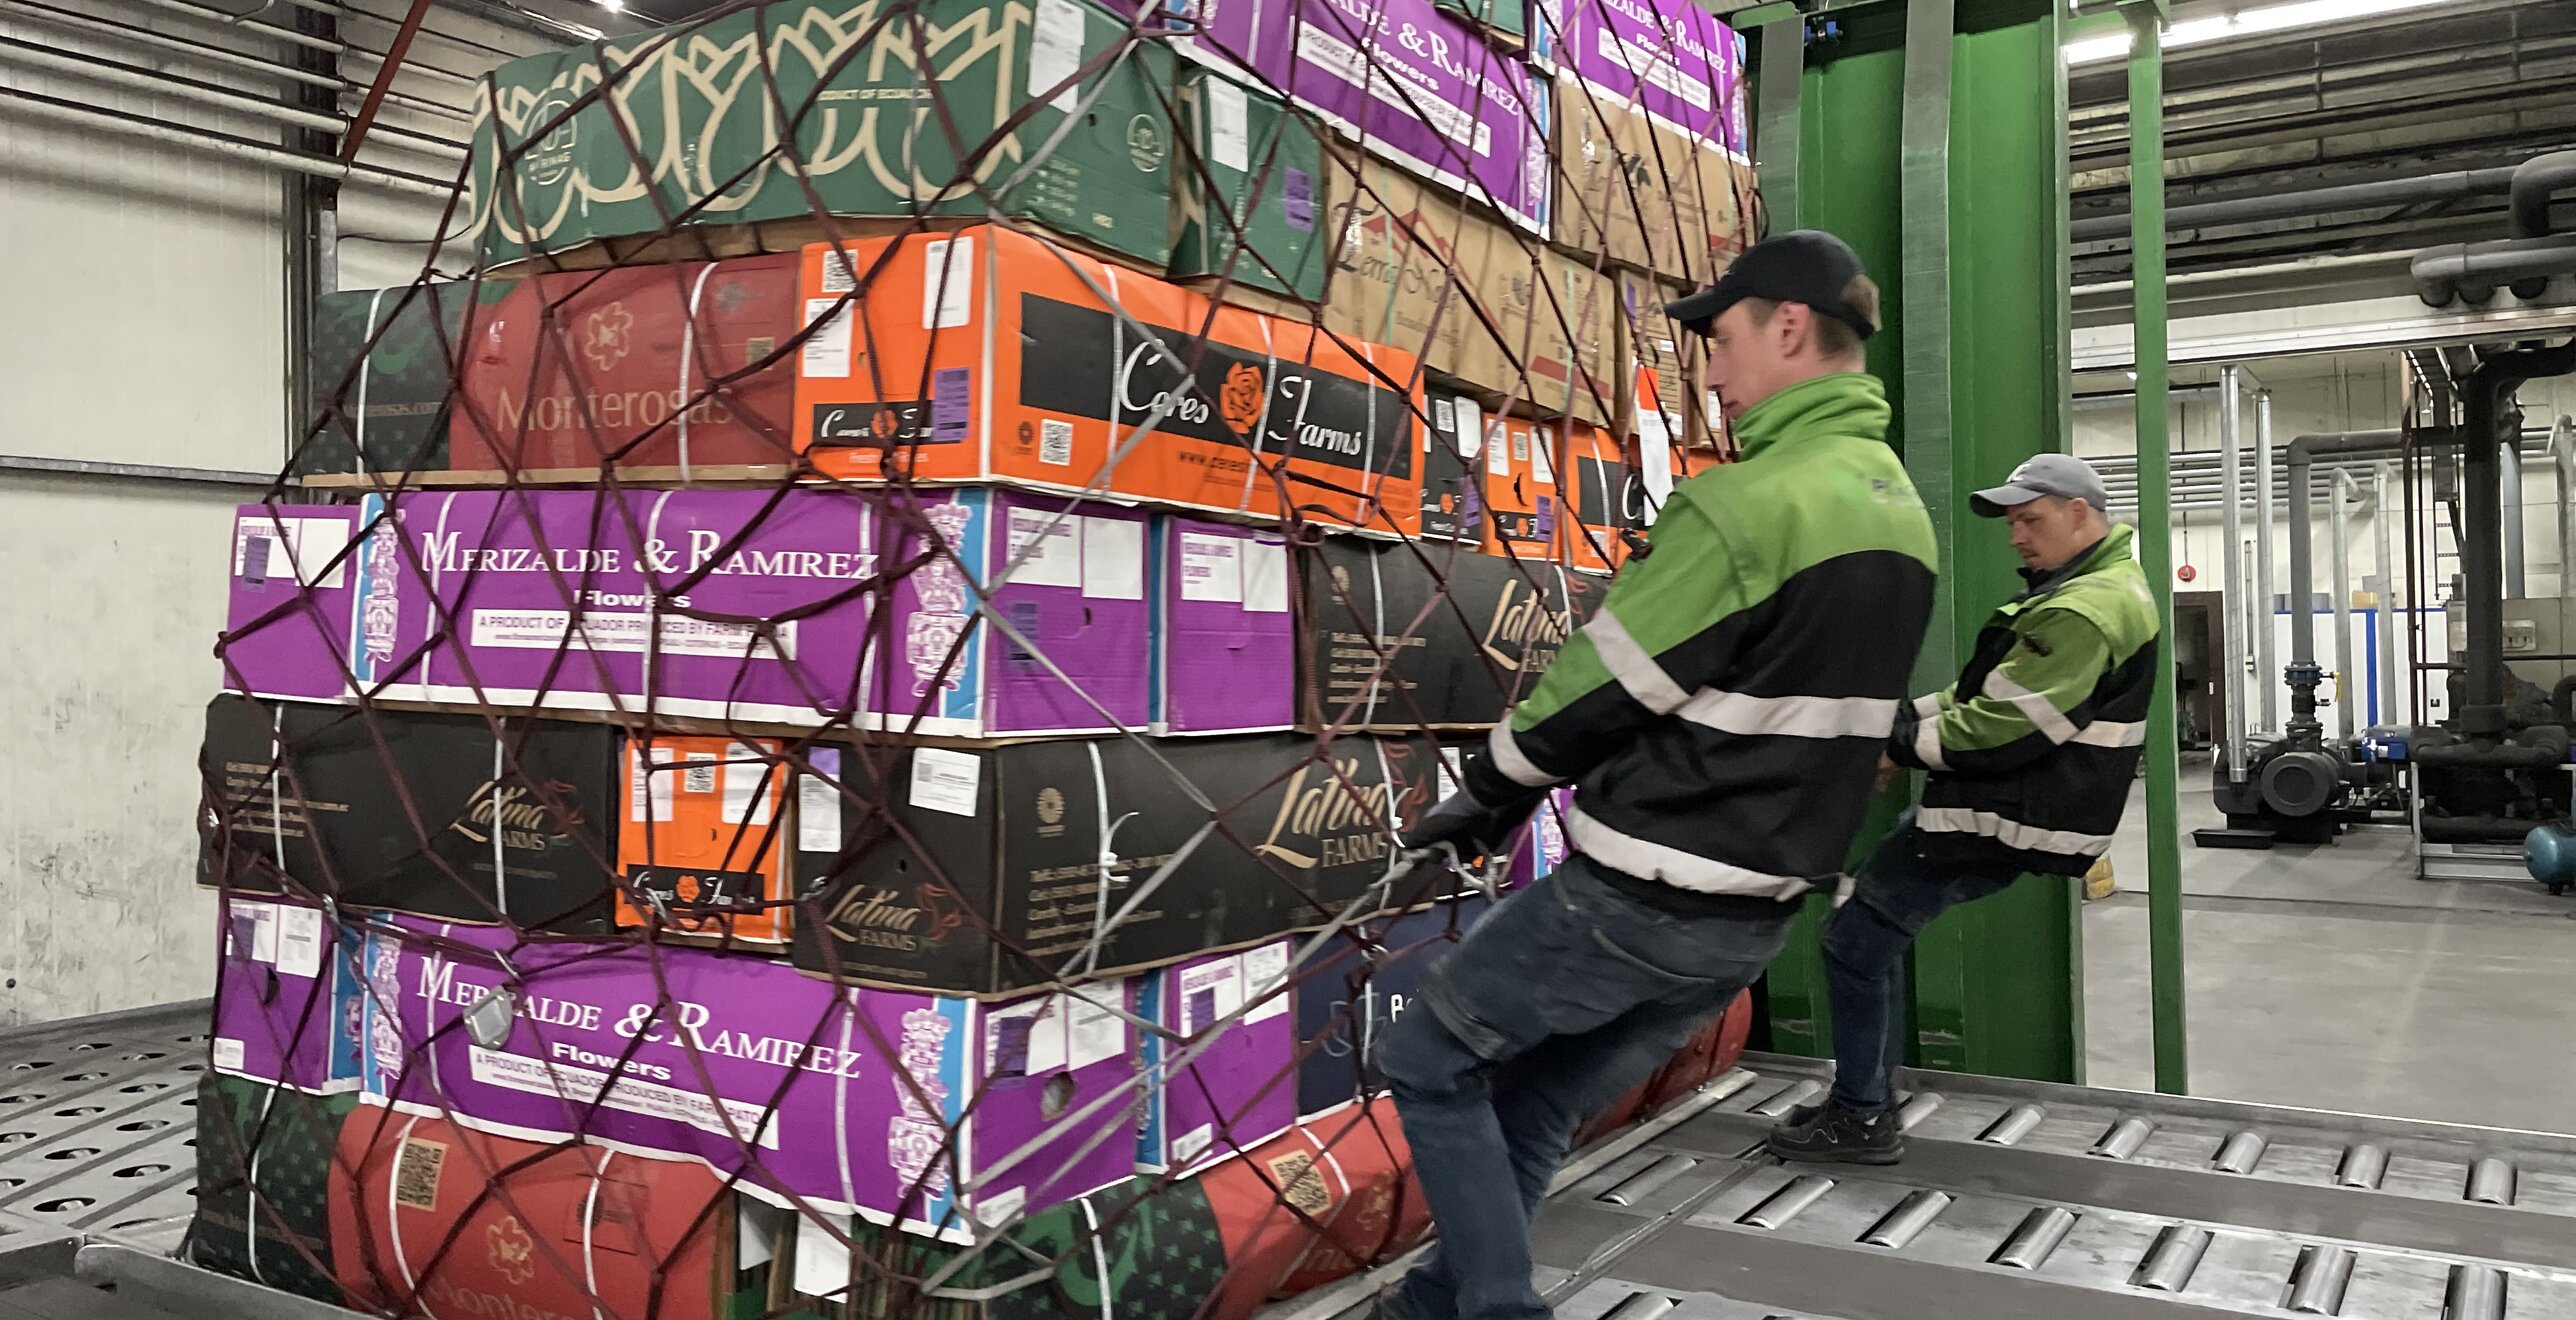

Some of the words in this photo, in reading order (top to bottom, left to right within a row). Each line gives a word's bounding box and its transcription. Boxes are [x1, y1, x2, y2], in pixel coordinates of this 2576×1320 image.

[1398, 22, 1431, 58] &
[497, 387, 734, 433] Monterosas
[1120, 338, 1210, 425] Ceres
[1267, 375, 1363, 457] Farms
[421, 531, 621, 573] MERIZALDE
[632, 538, 680, 575] &
[685, 529, 880, 579] RAMIREZ
[490, 615, 543, 629] PRODUCT
[546, 617, 565, 629] OF
[1254, 757, 1389, 868] Latina
[1320, 831, 1390, 868] FARMS
[825, 884, 921, 943] Latina
[857, 928, 917, 952] FARMS
[416, 956, 603, 1031] MERALDE
[613, 1003, 665, 1043] &
[667, 1001, 863, 1080] RAMIREZ
[484, 1055, 533, 1076] PRODUCT
[552, 1041, 672, 1081] Flowers
